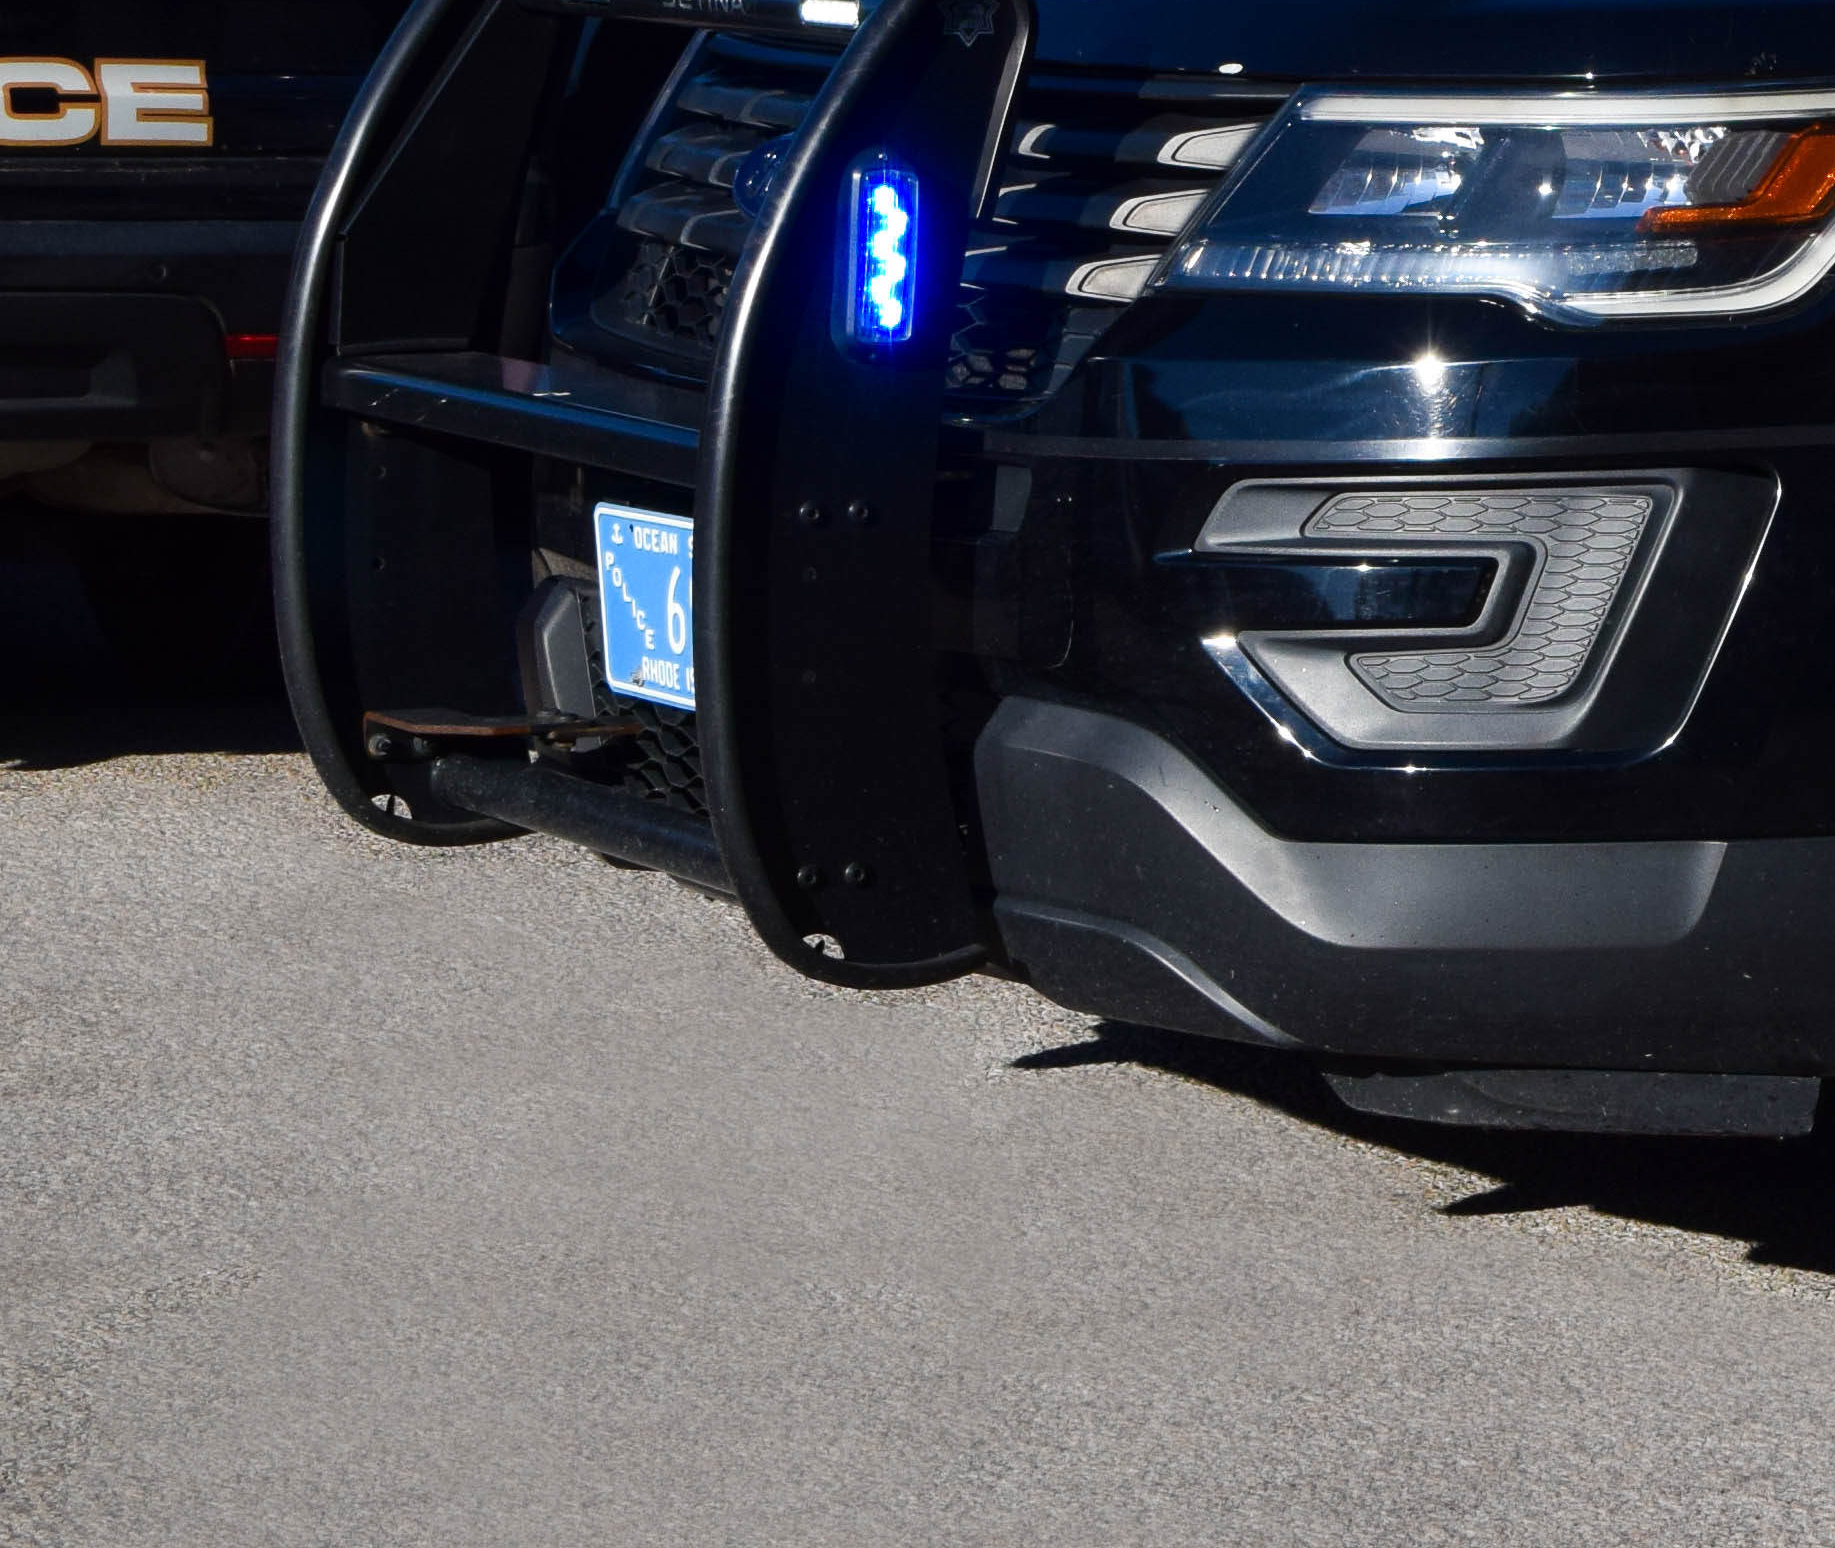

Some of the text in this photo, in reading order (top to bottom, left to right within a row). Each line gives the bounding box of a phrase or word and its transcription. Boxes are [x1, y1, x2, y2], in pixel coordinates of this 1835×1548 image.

[633, 525, 679, 556] OCEAN
[604, 551, 656, 651] POLICE
[667, 565, 693, 655] 6
[641, 655, 681, 690] RHODE
